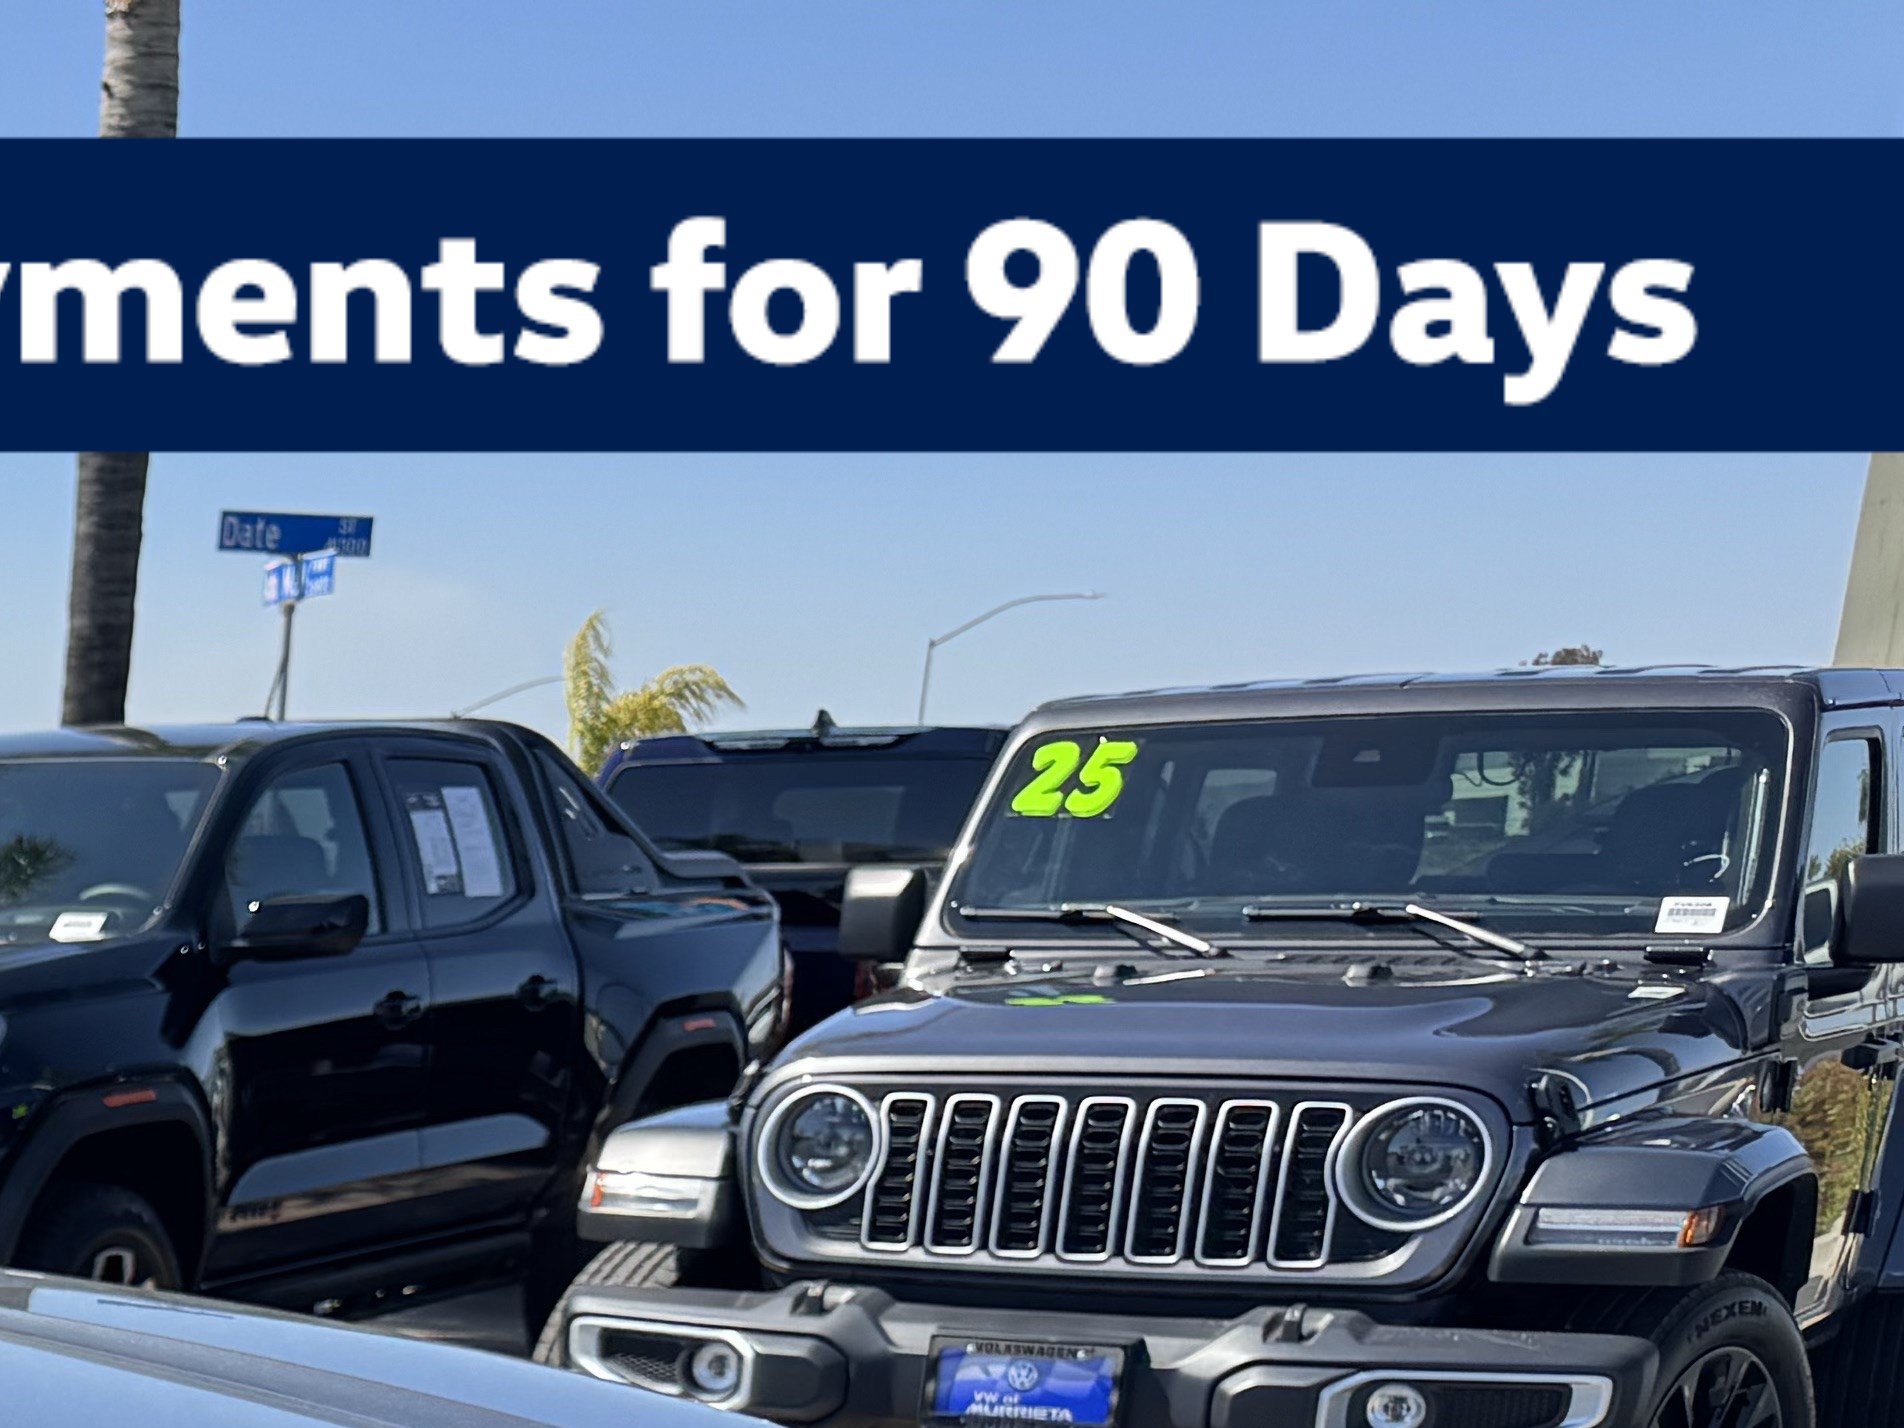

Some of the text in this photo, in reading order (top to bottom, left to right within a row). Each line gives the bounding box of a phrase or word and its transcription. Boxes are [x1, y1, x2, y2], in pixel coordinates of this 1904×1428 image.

[223, 516, 282, 549] Date
[1012, 740, 1138, 818] 25
[973, 1390, 999, 1405] VW
[965, 1402, 1073, 1423] MURRIETA
